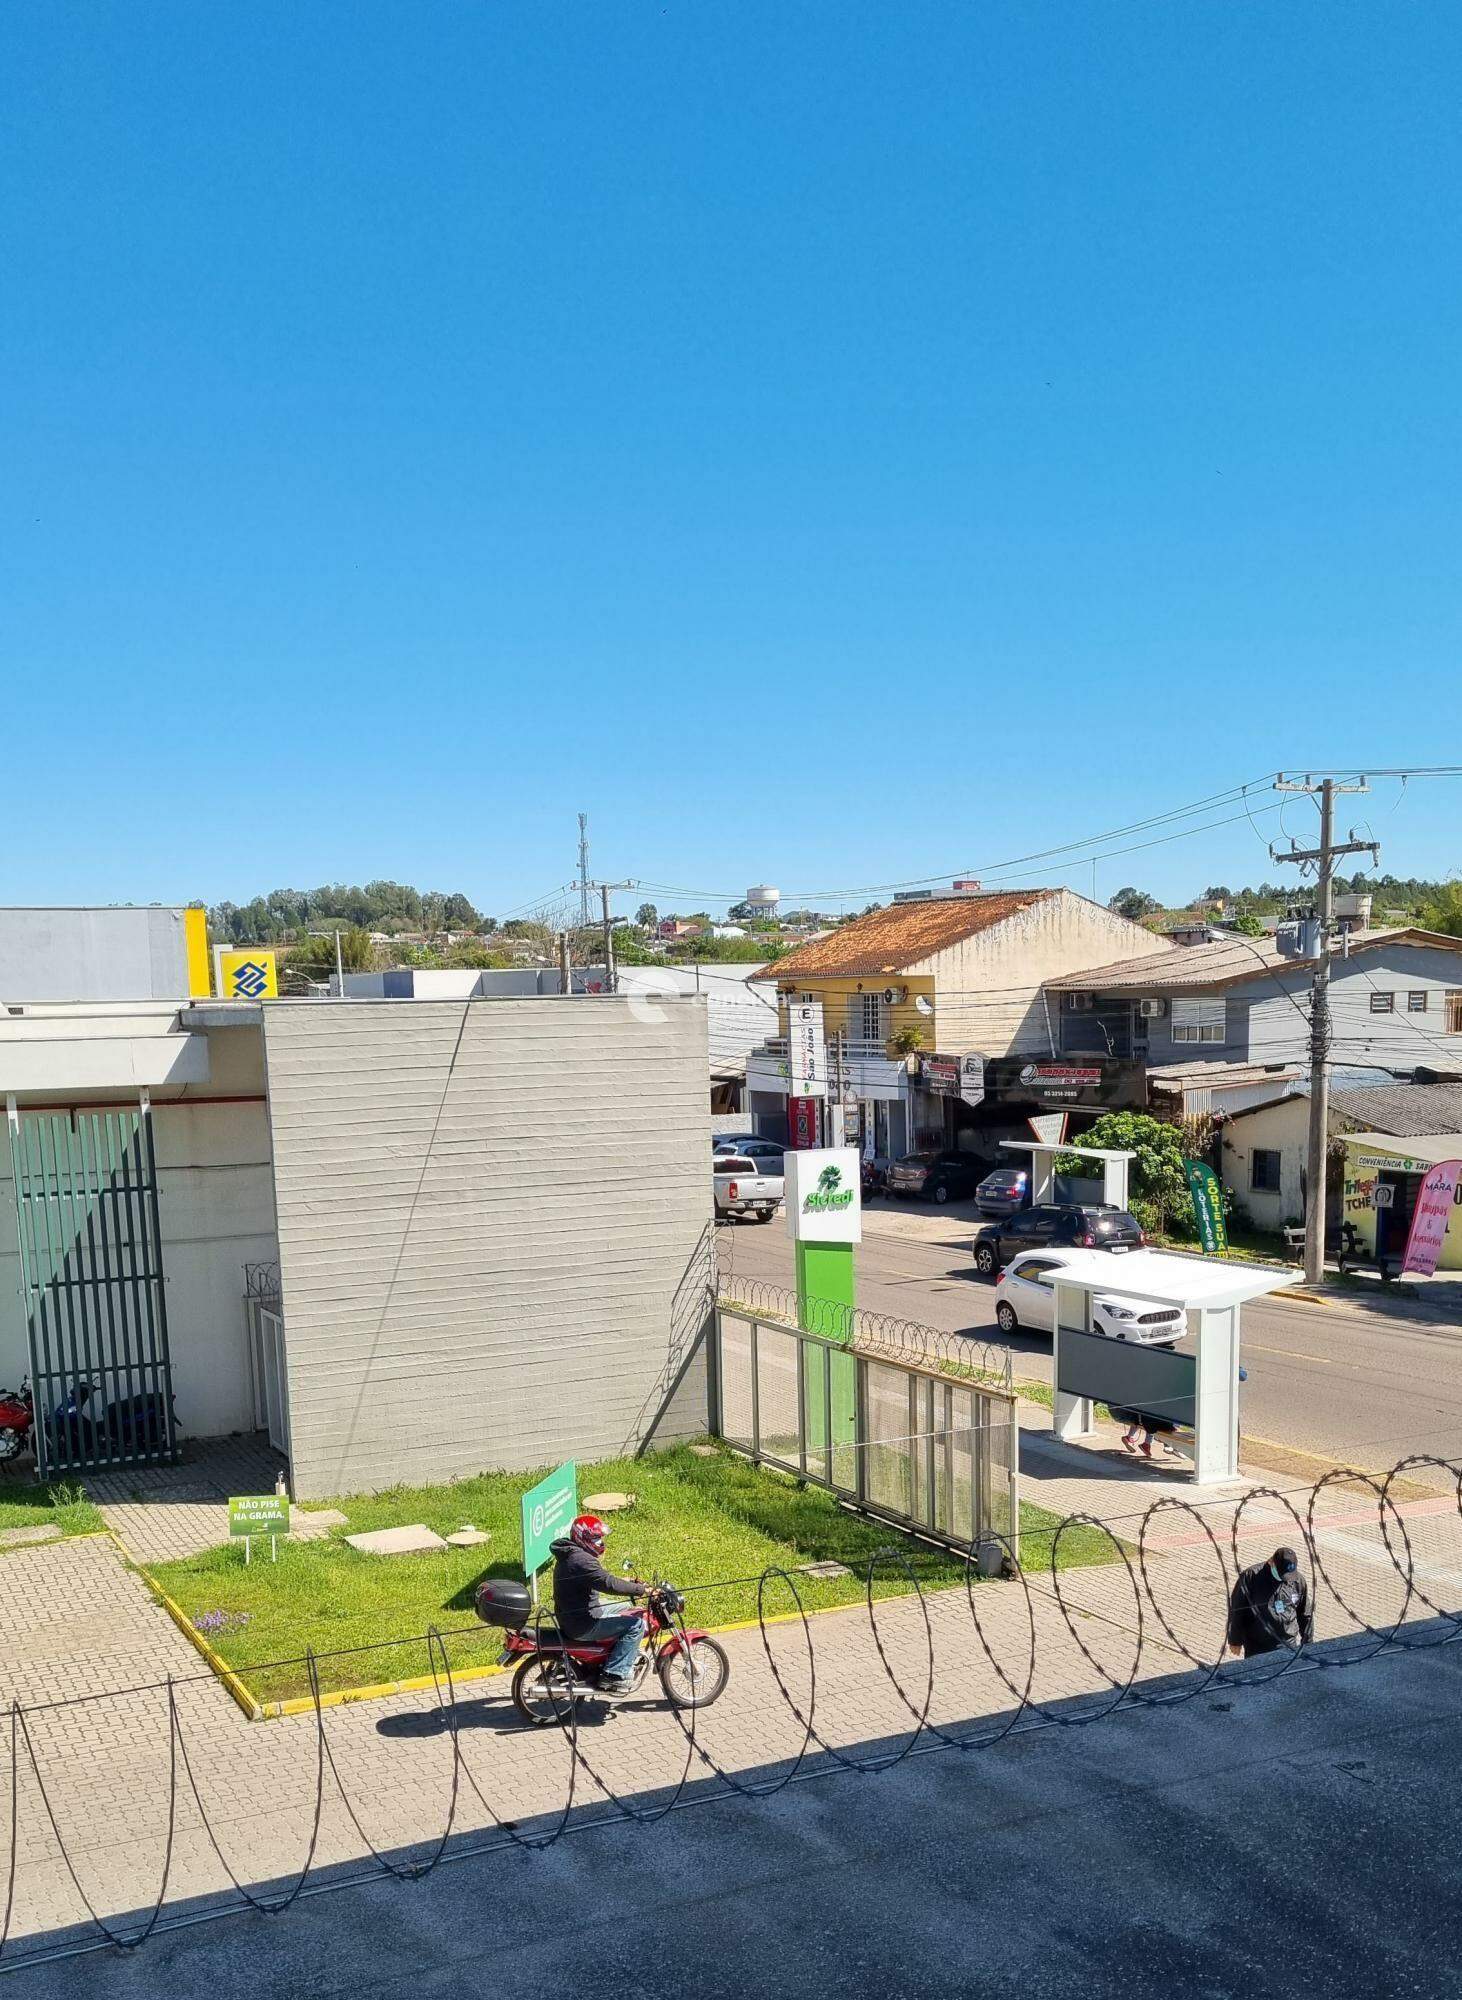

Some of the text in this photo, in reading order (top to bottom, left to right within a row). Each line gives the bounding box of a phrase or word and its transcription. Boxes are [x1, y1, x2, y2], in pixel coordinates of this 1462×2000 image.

[1358, 1156, 1433, 1170] CONVENIÊNCIA SABO
[1425, 1182, 1452, 1192] MARA
[807, 1189, 854, 1208] Sicredi
[1207, 1177, 1222, 1221] SORTE
[1215, 1223, 1226, 1250] SUA
[239, 1500, 280, 1510] NÃO PISE
[233, 1512, 247, 1521] NA
